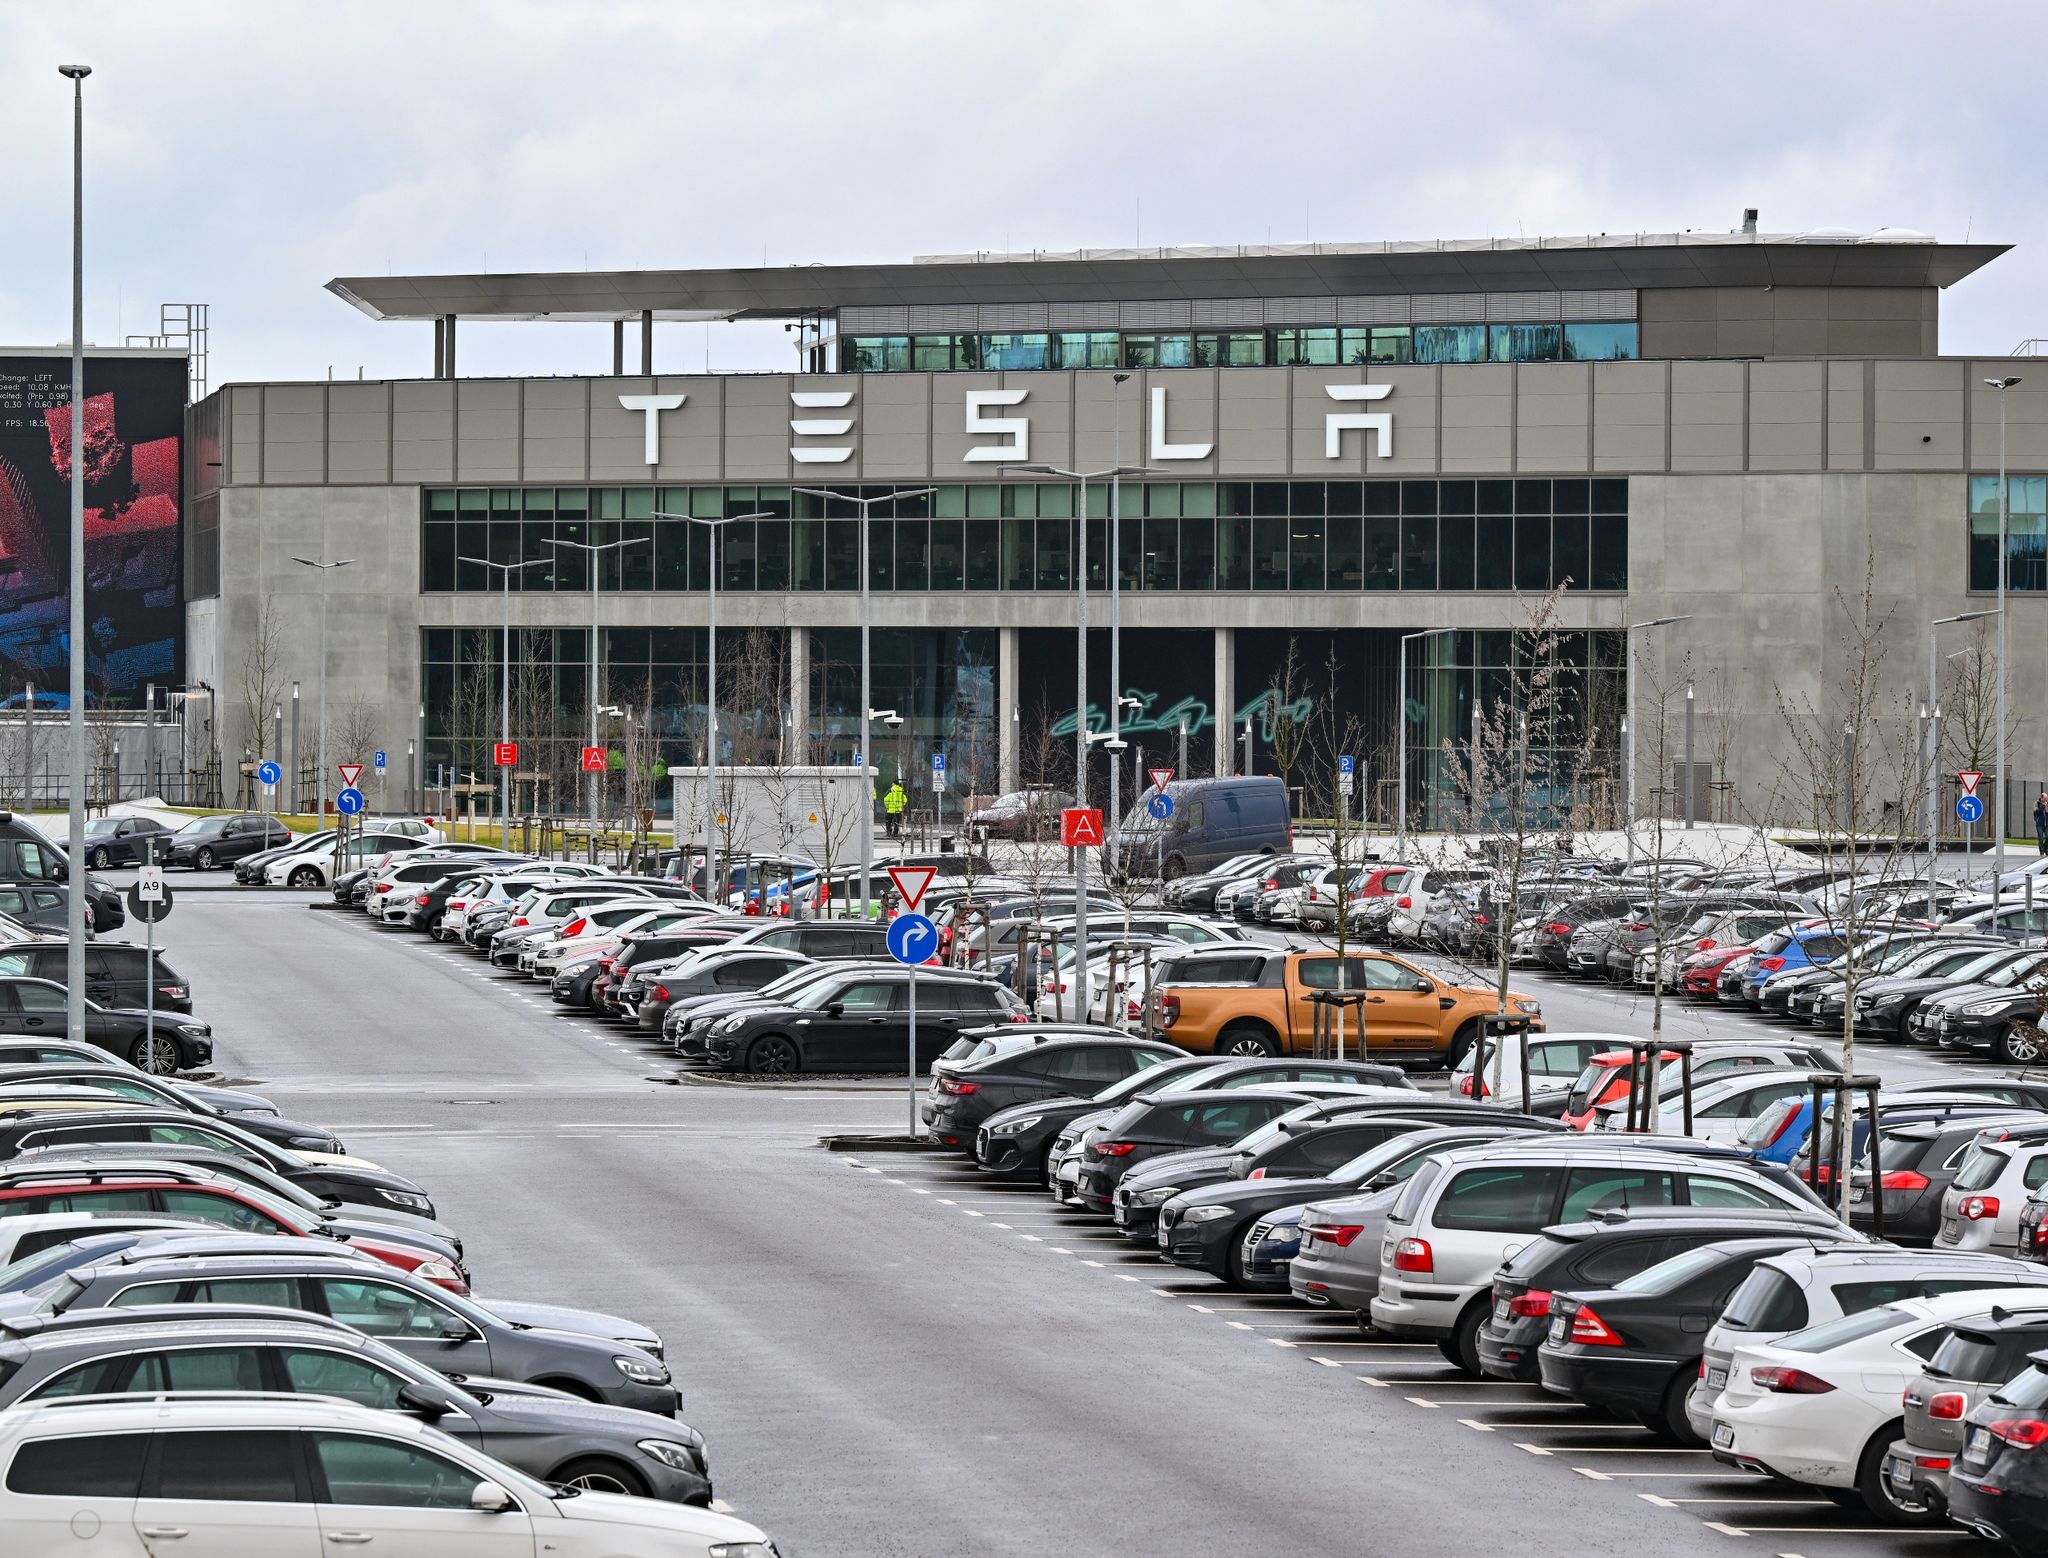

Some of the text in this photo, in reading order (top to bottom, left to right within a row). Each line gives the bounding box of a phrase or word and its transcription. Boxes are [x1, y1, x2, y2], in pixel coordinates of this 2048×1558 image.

[48, 392, 68, 400] 0.98)
[89, 402, 104, 410] deg
[5, 419, 23, 427] FPS:
[618, 384, 1395, 464] TESLA
[376, 753, 383, 765] P
[501, 746, 512, 760] E
[588, 750, 602, 766] A
[934, 756, 941, 768] P
[1341, 757, 1350, 771] P
[1073, 814, 1096, 838] A
[142, 881, 159, 891] A9
